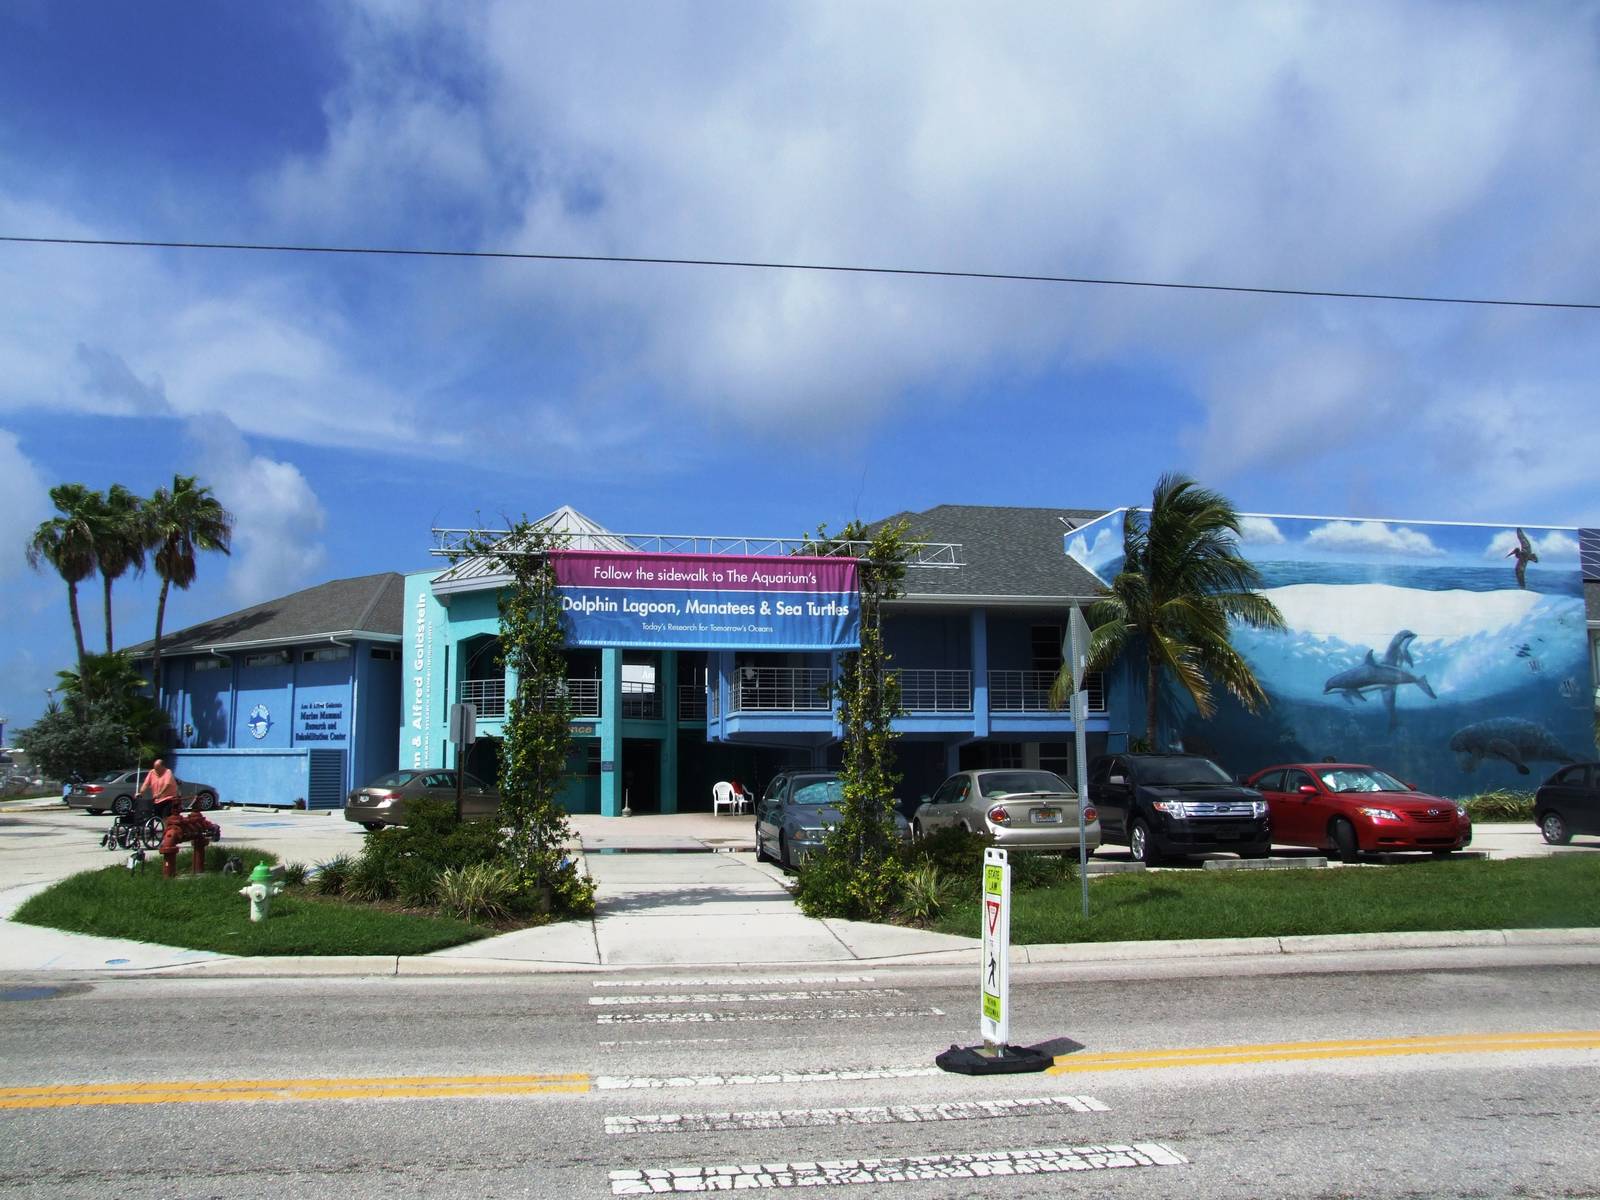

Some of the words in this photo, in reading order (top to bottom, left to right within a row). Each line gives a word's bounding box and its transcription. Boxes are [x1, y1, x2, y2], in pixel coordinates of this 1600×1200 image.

[594, 565, 633, 580] Follow
[636, 566, 654, 581] the
[658, 567, 709, 582] sidewalk
[712, 571, 724, 582] to
[726, 570, 748, 583] The
[751, 571, 817, 587] Aquarium's
[561, 595, 618, 615] Dolphin
[623, 598, 681, 616] Lagoon,
[685, 600, 755, 616] Manatees
[759, 600, 772, 616] &
[776, 601, 802, 616] Sea
[806, 600, 850, 616] Turtles
[414, 592, 426, 672] Goldstein
[642, 622, 666, 632] Today's
[668, 623, 698, 631] Research
[710, 624, 747, 632] Tomorrow's
[748, 625, 773, 633] Oceans
[412, 676, 423, 730] Alfred
[411, 735, 422, 748] &
[987, 869, 1000, 880] STATE
